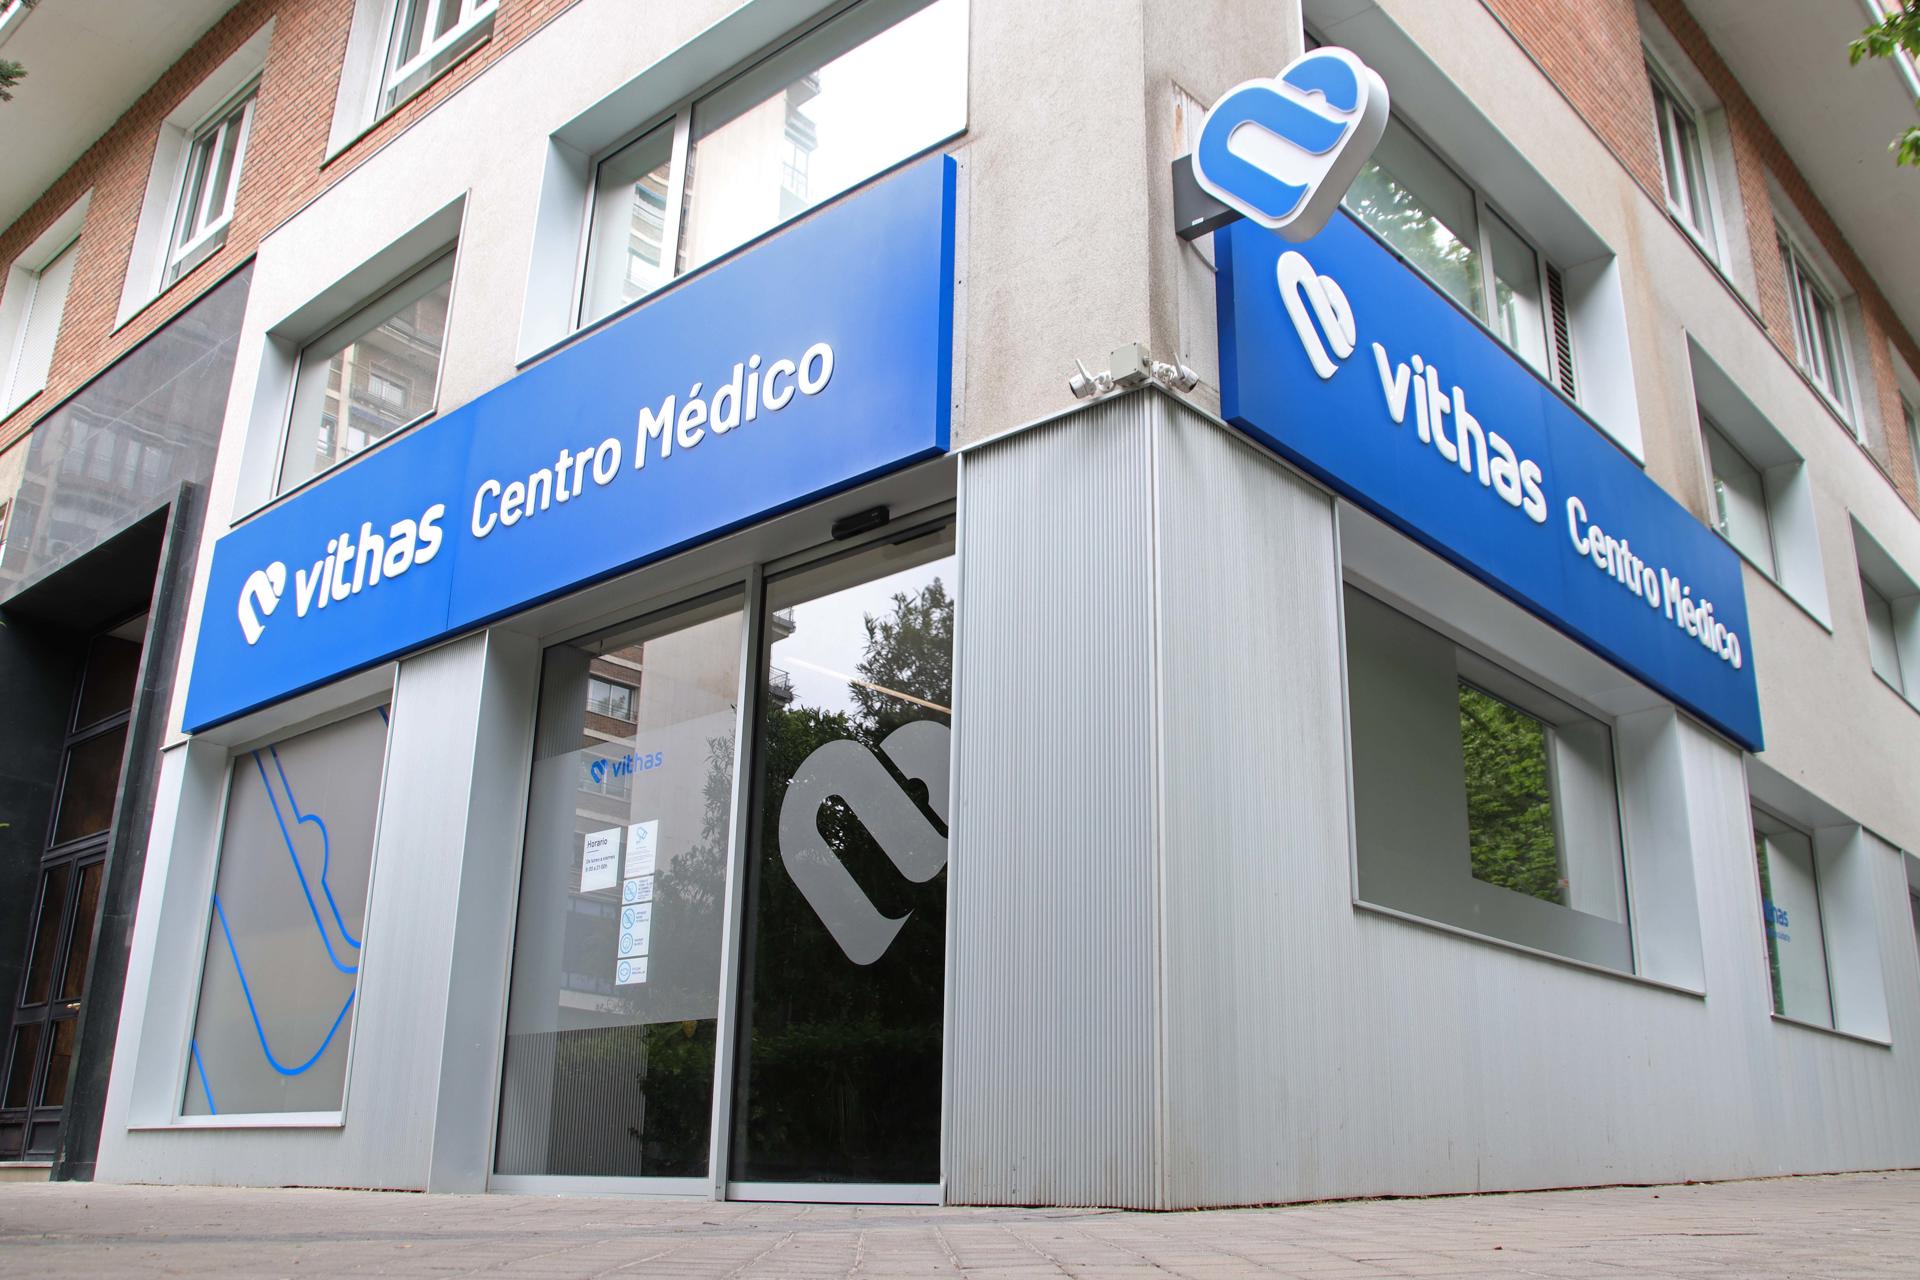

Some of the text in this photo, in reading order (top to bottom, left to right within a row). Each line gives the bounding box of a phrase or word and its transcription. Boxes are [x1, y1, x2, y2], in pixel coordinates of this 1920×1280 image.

[295, 341, 834, 618] vithas Centro Médico
[1372, 341, 1742, 669] vithas Centro Médico
[612, 751, 663, 777] vithas
[587, 838, 608, 848] Horario
